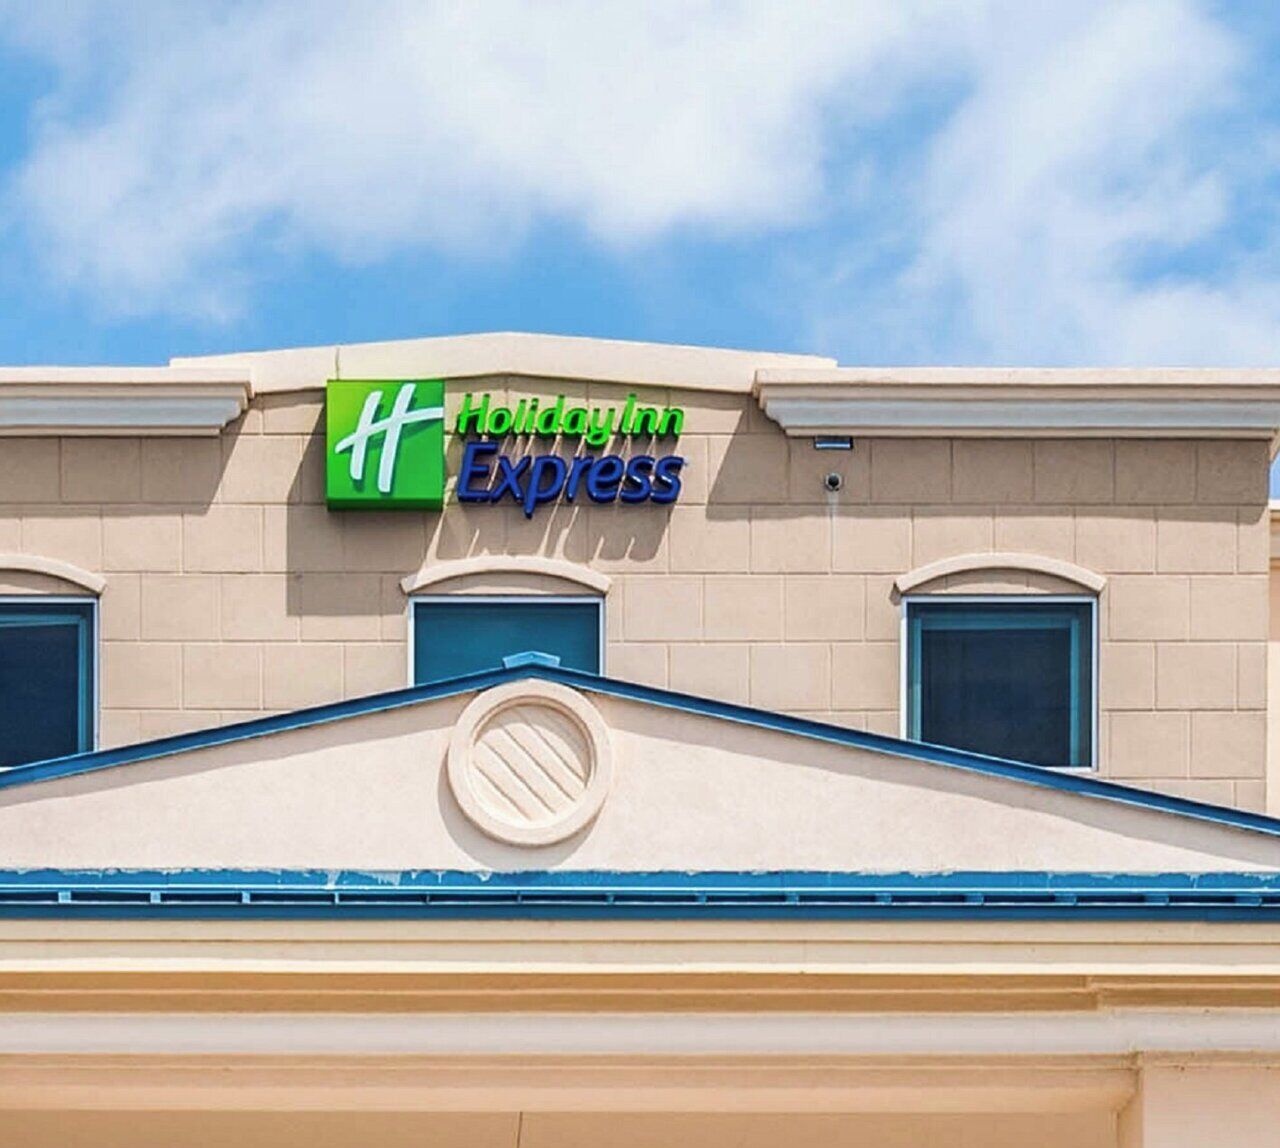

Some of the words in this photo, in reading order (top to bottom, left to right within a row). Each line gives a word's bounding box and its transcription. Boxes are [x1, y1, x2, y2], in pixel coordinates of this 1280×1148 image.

[457, 393, 616, 449] Holiday
[621, 393, 685, 437] Inn
[457, 441, 685, 519] Express
